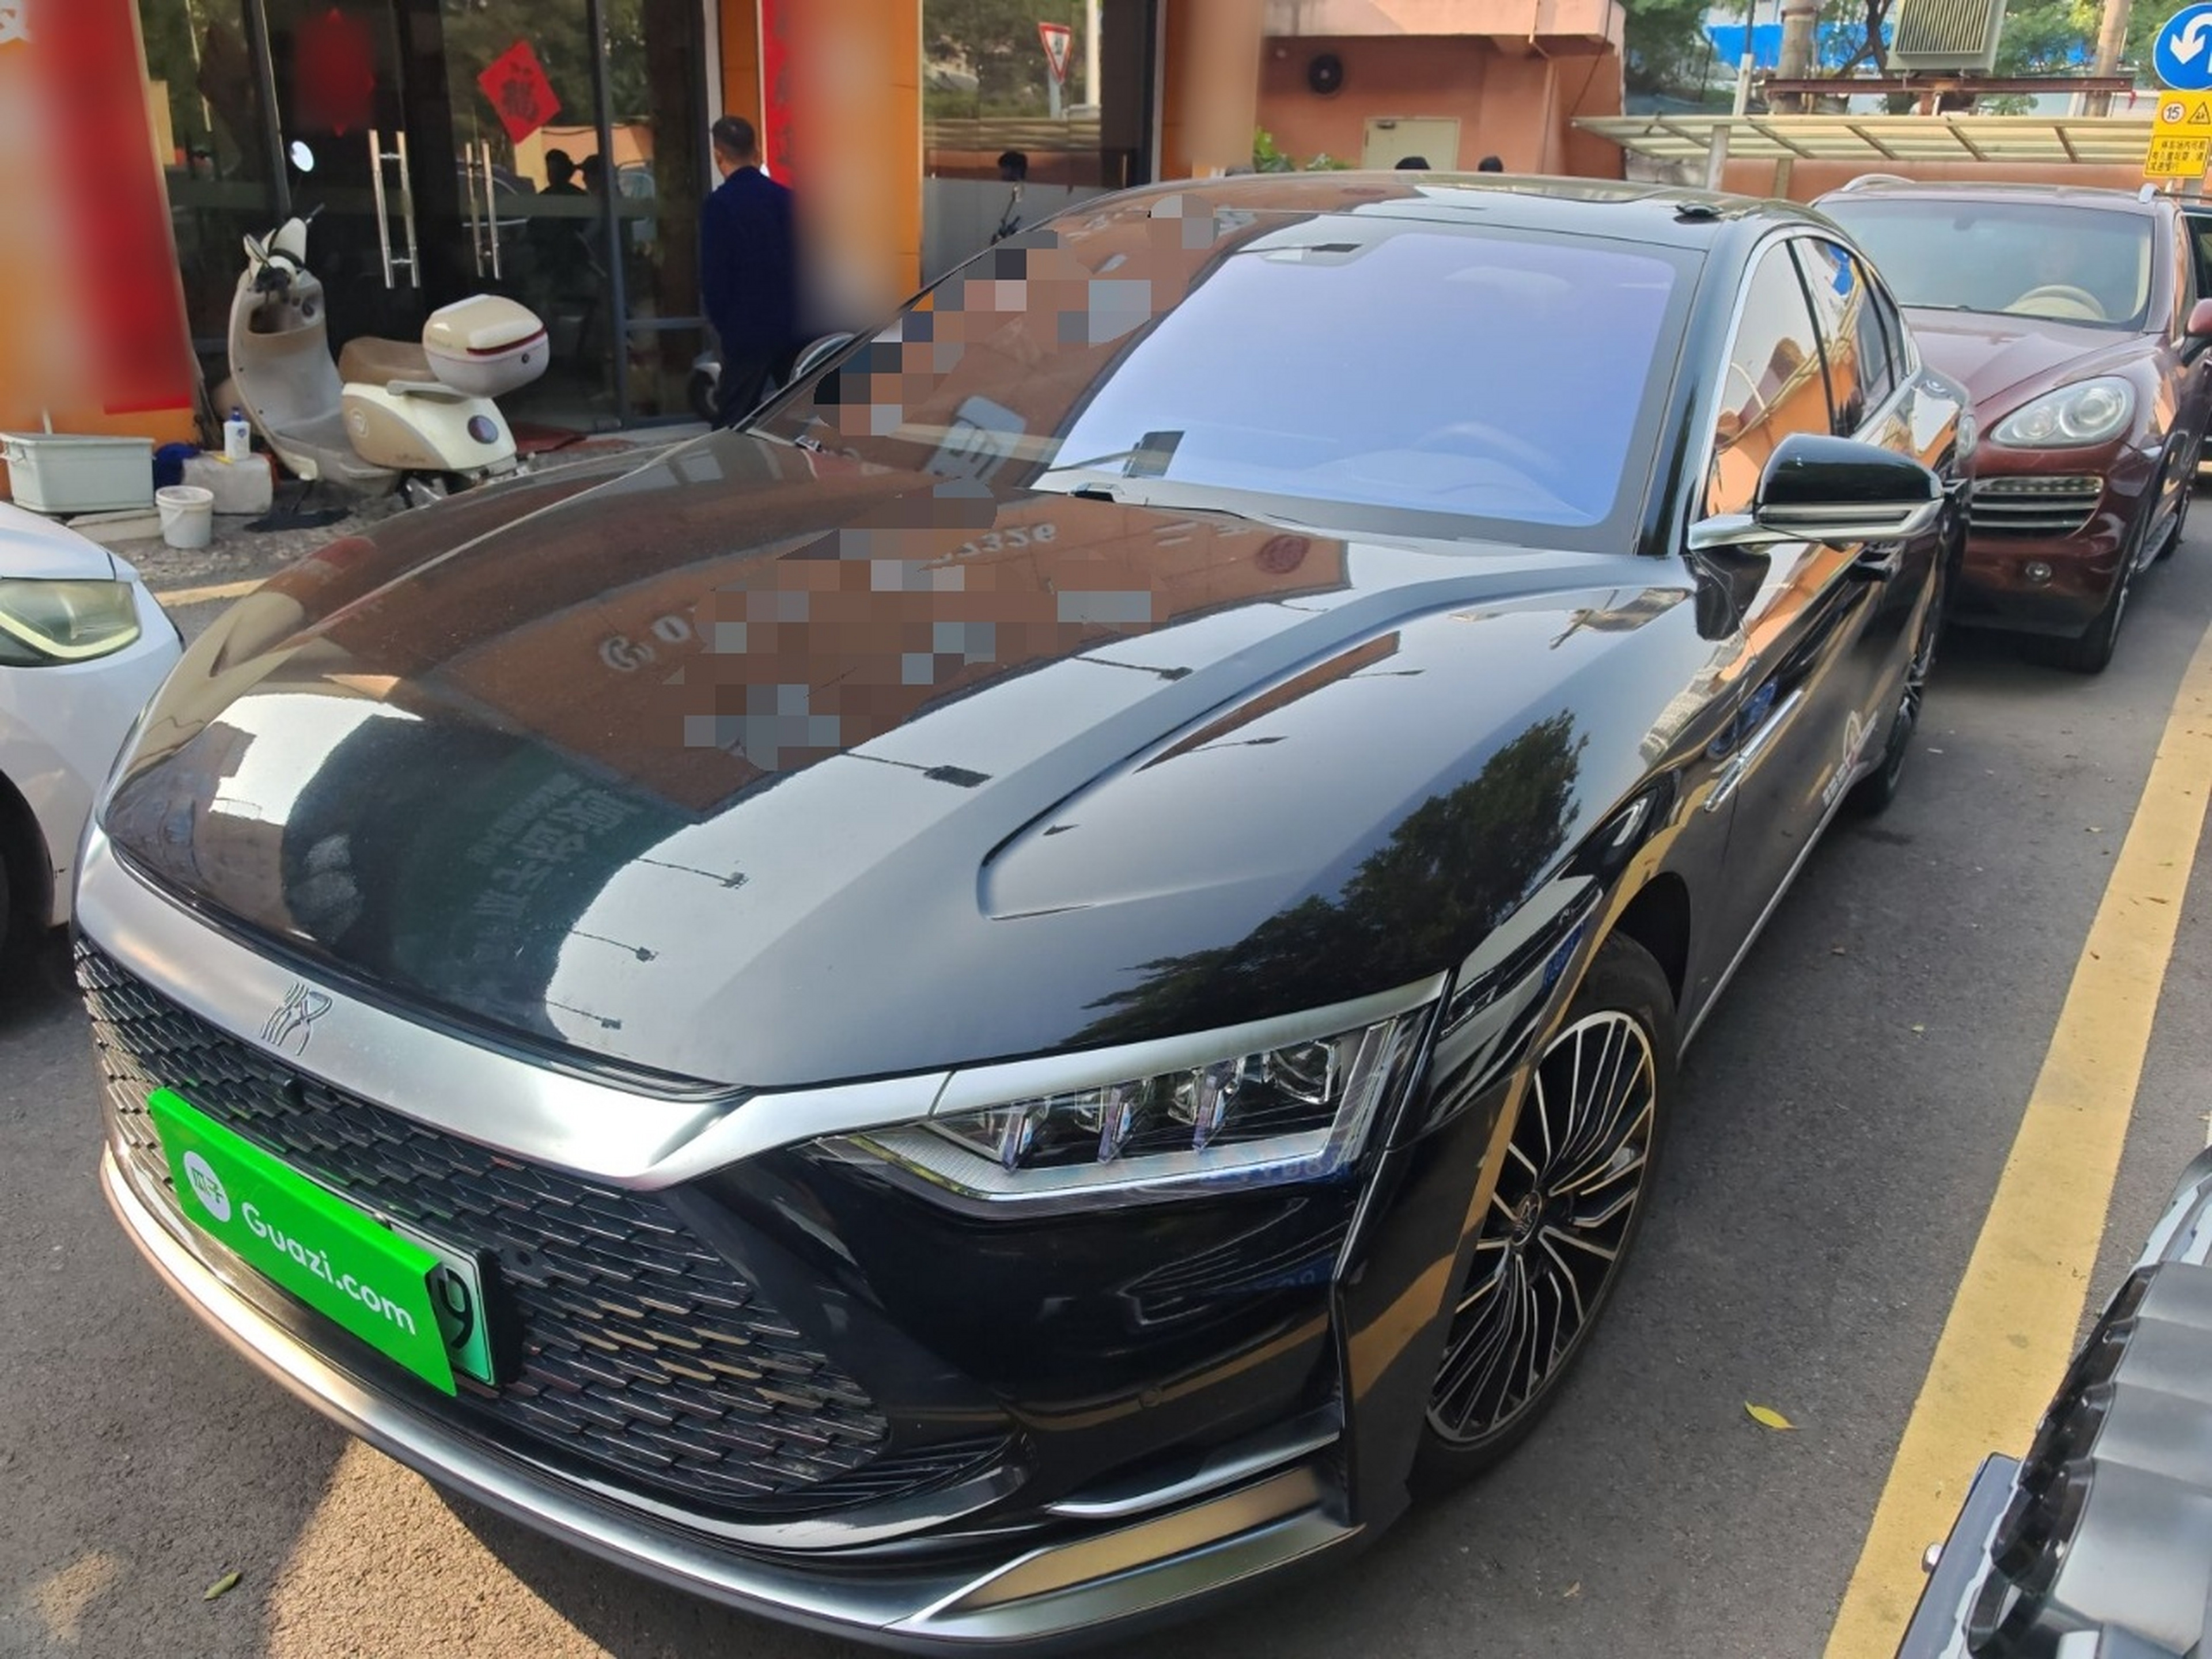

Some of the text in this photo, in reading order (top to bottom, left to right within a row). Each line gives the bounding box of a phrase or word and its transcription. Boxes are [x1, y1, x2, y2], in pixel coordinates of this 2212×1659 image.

[2166, 106, 2180, 120] 15
[190, 1166, 225, 1205] 瓜子
[241, 1202, 416, 1336] Guazi.com
[438, 1267, 474, 1350] 9
